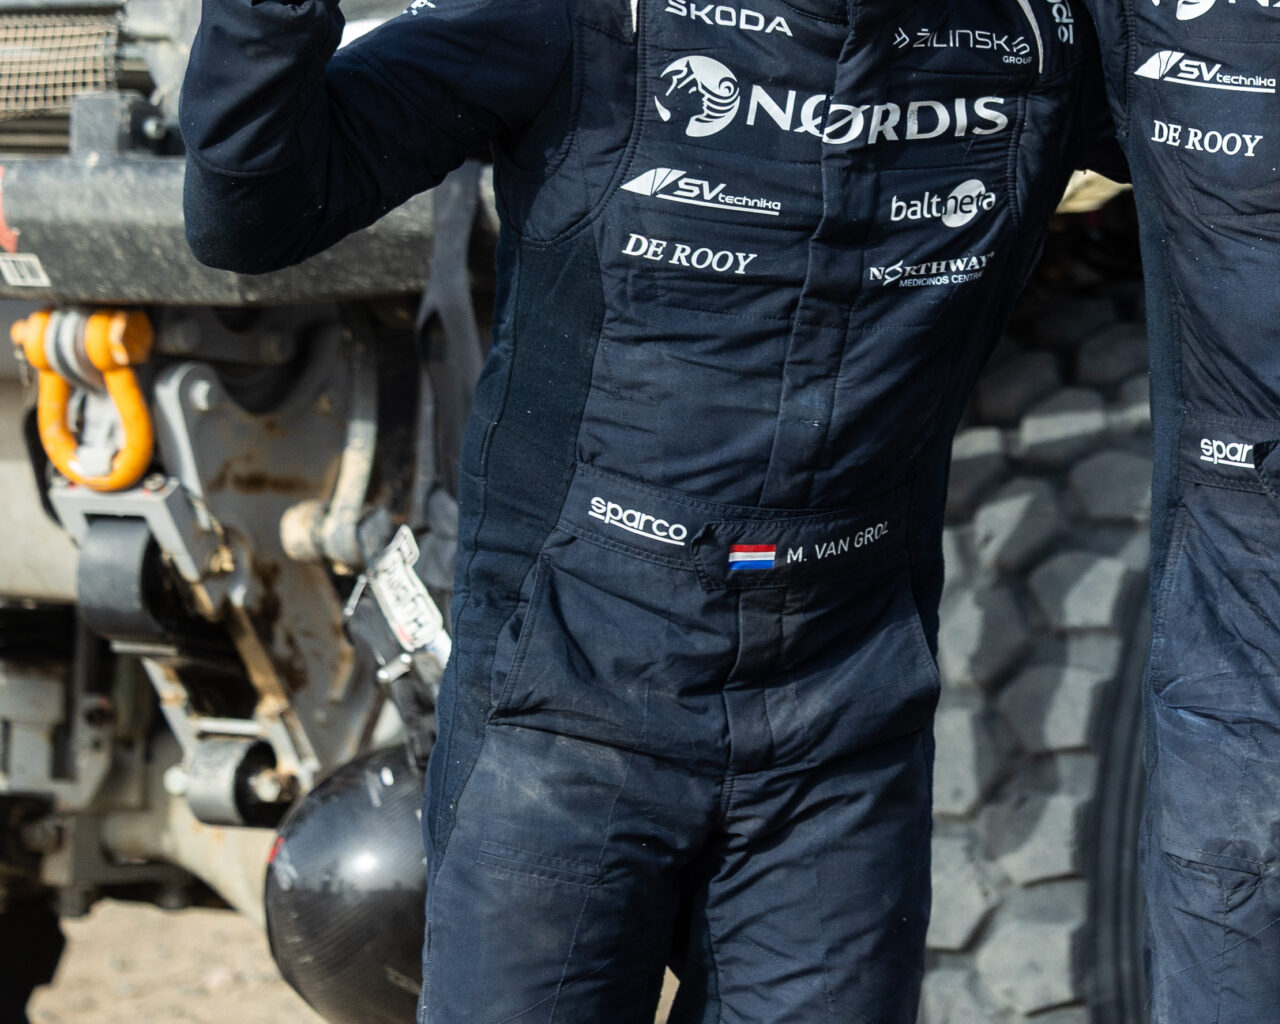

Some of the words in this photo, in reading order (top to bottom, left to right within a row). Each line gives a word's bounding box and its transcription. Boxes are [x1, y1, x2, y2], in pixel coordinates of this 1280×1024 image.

[1002, 55, 1033, 65] GROUP
[1216, 73, 1277, 87] technika
[1151, 119, 1182, 146] DE
[1186, 127, 1264, 157] ROOY
[717, 192, 782, 211] technika
[891, 186, 997, 222] baltneta
[622, 233, 666, 262] DE
[668, 245, 757, 275] ROOY
[899, 276, 950, 287] MEDICINOS
[589, 496, 688, 542] sparco
[786, 547, 807, 564] M.
[815, 536, 850, 560] VAN
